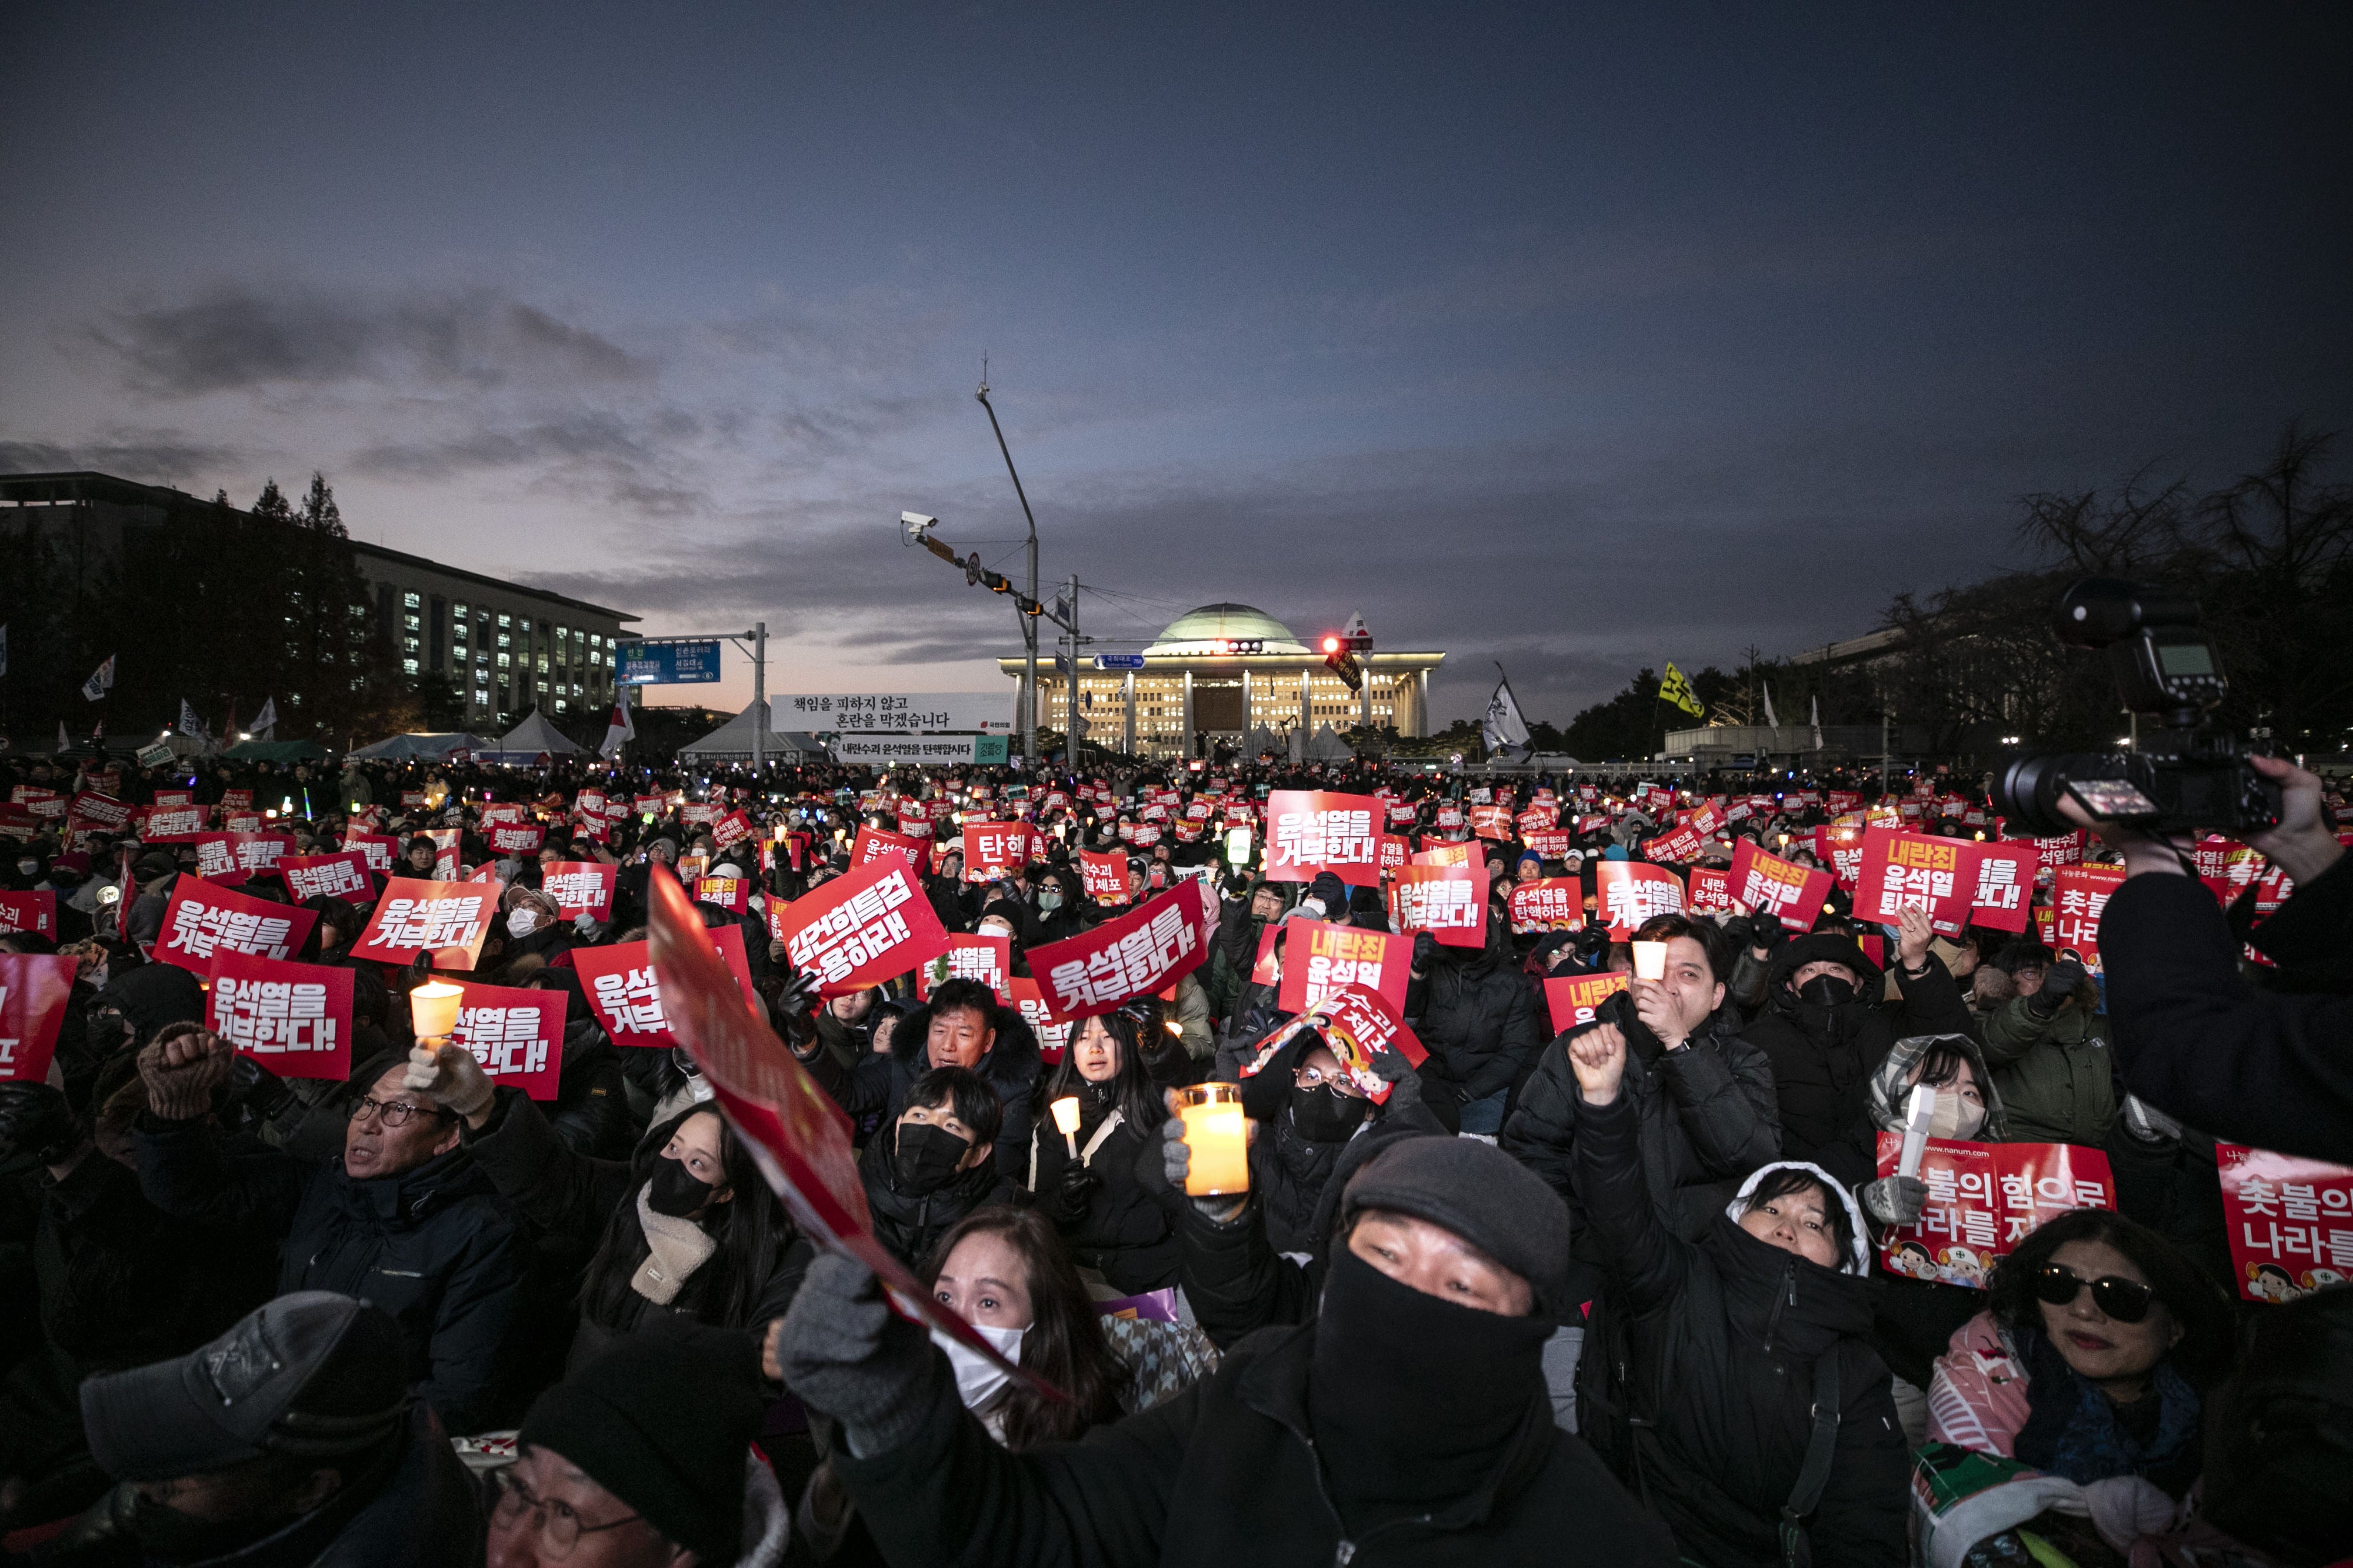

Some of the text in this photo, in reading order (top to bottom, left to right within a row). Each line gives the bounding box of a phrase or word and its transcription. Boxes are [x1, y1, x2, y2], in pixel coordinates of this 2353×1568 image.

[794, 696, 908, 711] 책임을 피하지 않고
[836, 712, 950, 728] 혼란을 막겠습니다
[842, 743, 971, 755] 내란수괴 윤석열을 탄핵합시다
[1651, 790, 1671, 799] 윤석열을
[151, 811, 198, 825] 윤석열을
[1391, 805, 1414, 814] 윤석열을
[1520, 812, 1546, 824] 내란수괴
[712, 818, 739, 836] 윤석열을
[901, 820, 931, 830] 윤석열을
[1277, 810, 1371, 840] 윤석열을
[1537, 819, 1551, 828] 체포
[1694, 811, 1715, 828] 윤석열
[148, 822, 200, 837] 거부한다!
[495, 828, 538, 842] 윤석열을
[716, 826, 744, 843] 탄핵하라
[494, 839, 539, 850] 거부한다!
[1136, 834, 1161, 845] 규명하라!
[1548, 835, 1568, 843] 힘으로
[1548, 843, 1568, 852] 지키자
[1669, 830, 1695, 849] 힘으로
[1276, 836, 1375, 866] 거부한다!
[1675, 840, 1700, 857] 지키자
[1887, 839, 1957, 871] 내란죄
[2065, 847, 2080, 862] 체포
[288, 860, 355, 886] 윤석열을
[1750, 852, 1811, 888] 내란죄
[2061, 870, 2088, 879] 나눔문화
[291, 873, 365, 900] 거부한다!
[543, 872, 604, 893] 윤석열을
[701, 879, 738, 893] 내란죄
[1096, 877, 1122, 892] 체포
[1746, 869, 1804, 905] 윤석열
[1883, 866, 1954, 898] 윤석열
[1399, 879, 1473, 908] 윤석열을
[1514, 887, 1568, 906] 윤석열을
[1607, 879, 1681, 908] 윤석열을
[1694, 889, 1729, 906] 윤석열
[380, 896, 483, 924] 윤석열을
[788, 869, 913, 968] 김건희특검
[1401, 903, 1478, 930] 거부한다!
[1514, 902, 1570, 920] 탄핵하라
[173, 899, 292, 945] 윤석열을
[368, 920, 481, 950] 거부한다!
[1050, 903, 1184, 994] 윤석열을
[1310, 929, 1387, 963] 내란죄
[1057, 922, 1196, 1013] 거부한다!
[1307, 955, 1382, 990] 윤석열
[215, 976, 326, 1019] 윤석열을
[215, 1012, 336, 1053] 거부한다!
[1924, 1144, 1990, 1159] www.nanum.com
[1892, 1165, 1993, 1208] 불의
[2238, 1179, 2353, 1222] 촛불의
